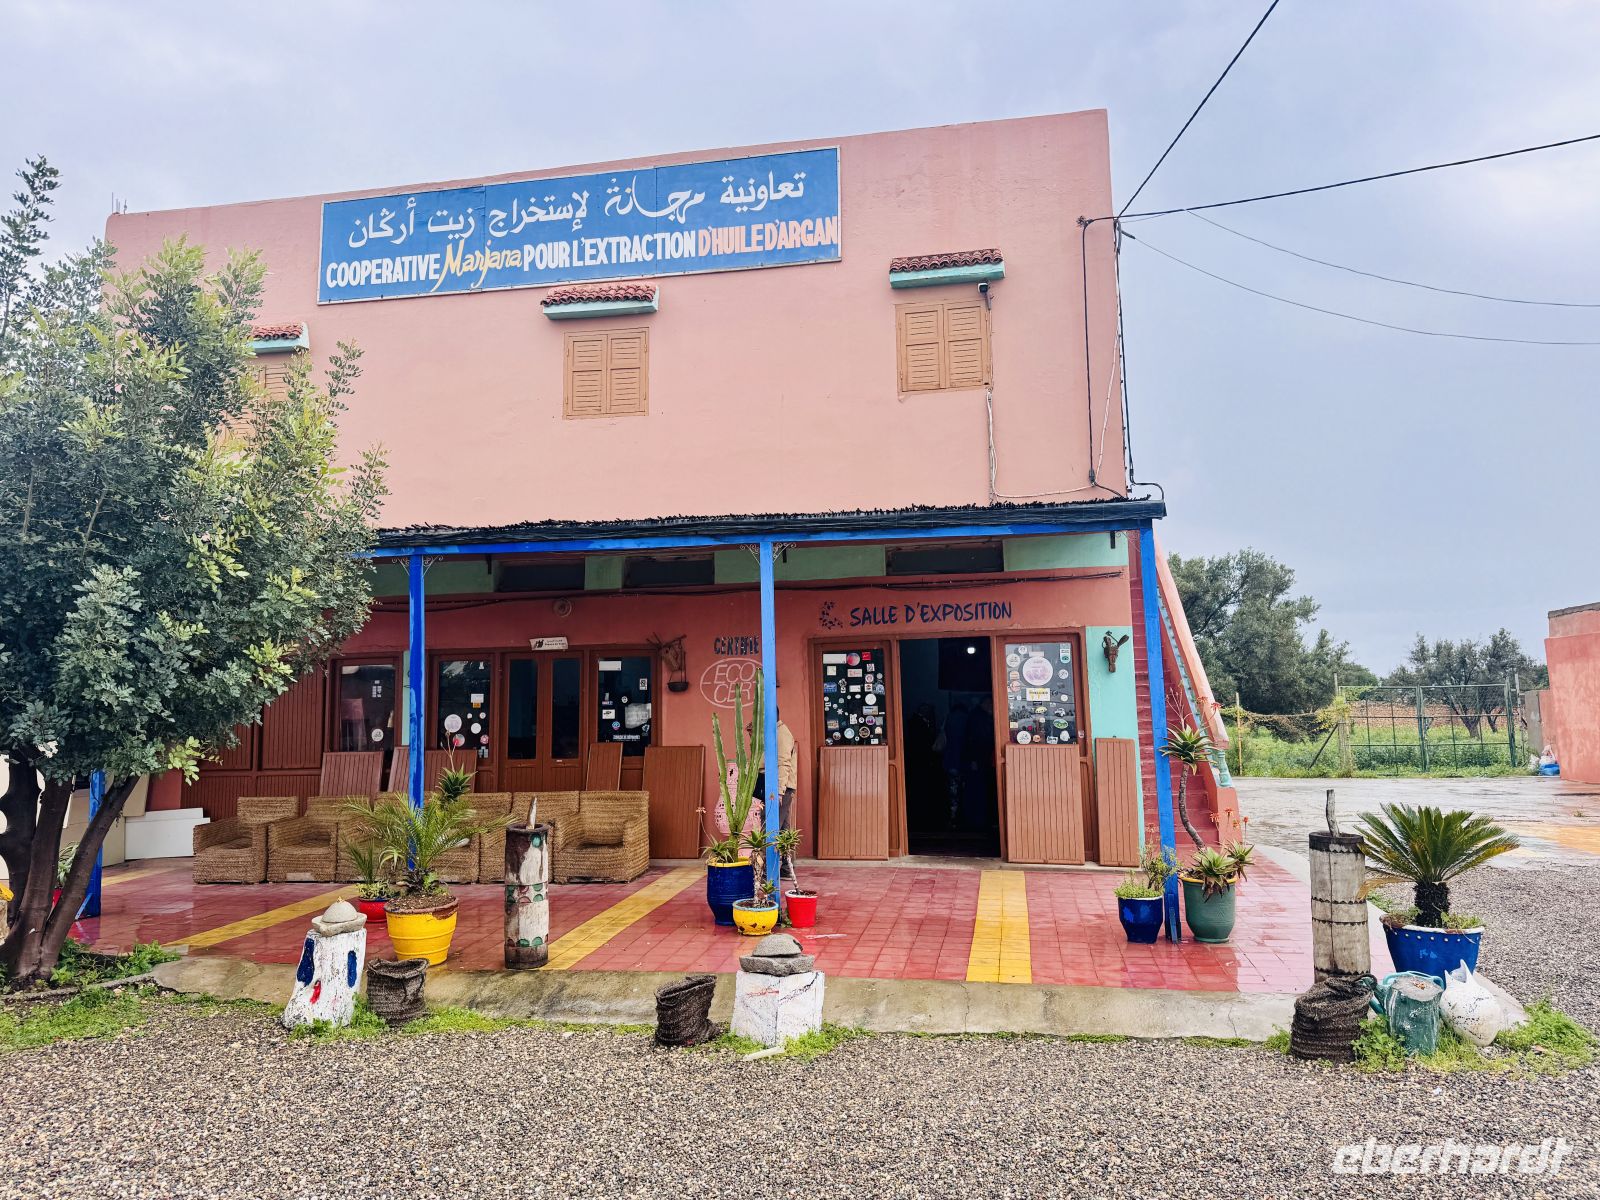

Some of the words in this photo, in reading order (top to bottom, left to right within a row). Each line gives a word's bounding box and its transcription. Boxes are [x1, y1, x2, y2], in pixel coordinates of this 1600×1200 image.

[720, 170, 807, 213] تعاونية
[427, 206, 476, 241] زيت
[326, 253, 441, 288] COOPERATIVE
[430, 240, 523, 292] Marjana
[523, 240, 571, 272] POUR
[572, 229, 696, 267] L'EXTRACTION
[849, 605, 899, 627] SALLE
[903, 601, 1012, 624] D'EXPOSITION
[713, 662, 756, 684] ECO
